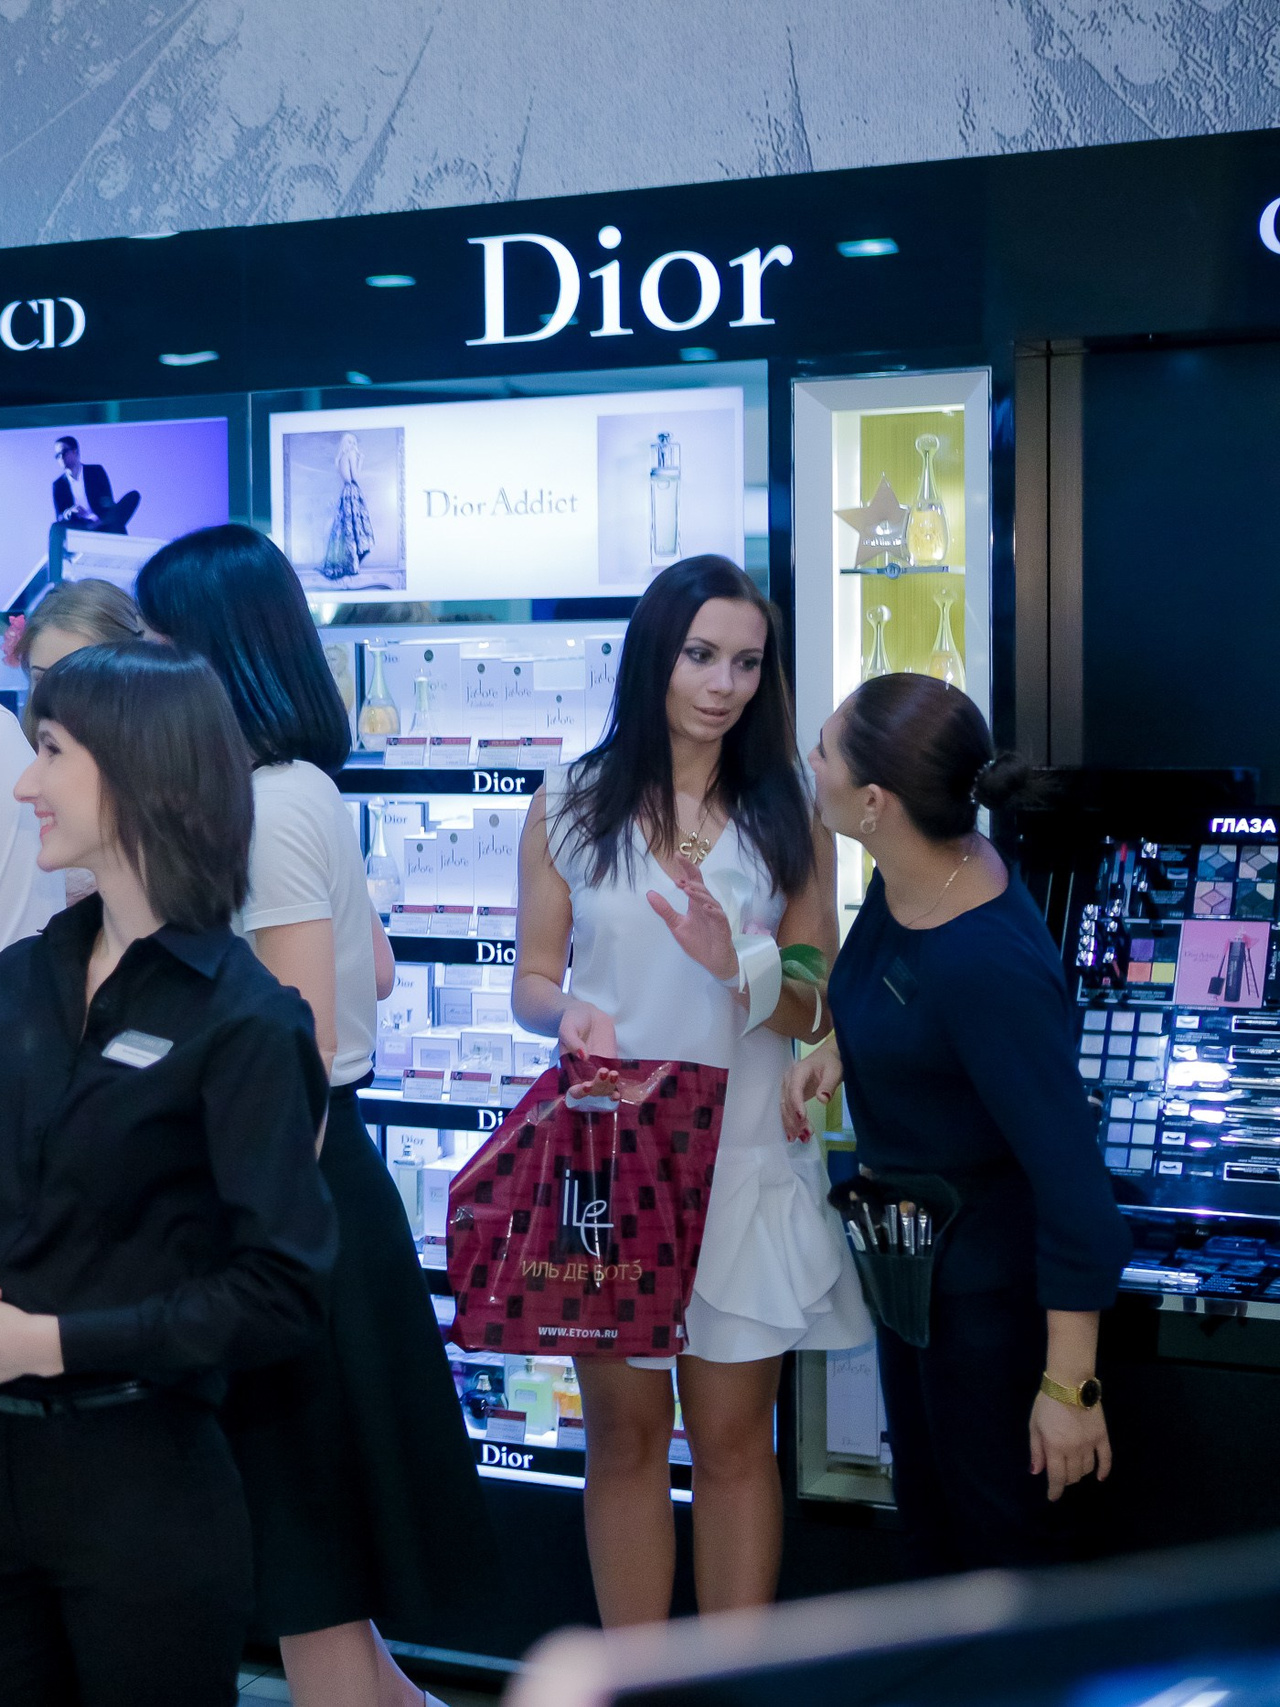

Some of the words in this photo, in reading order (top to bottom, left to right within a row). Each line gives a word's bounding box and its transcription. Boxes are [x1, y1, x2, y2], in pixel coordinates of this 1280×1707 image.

[465, 225, 793, 347] Dior
[423, 489, 486, 517] Dior
[491, 487, 578, 516] Addict
[472, 771, 525, 793] Dior
[1211, 818, 1276, 833] ГЛАЗА
[522, 1261, 559, 1278] ИЛЬ
[563, 1263, 588, 1282] ДЕ
[538, 1326, 618, 1338] WWW.ETOYA.RU
[481, 1444, 534, 1469] Dior
